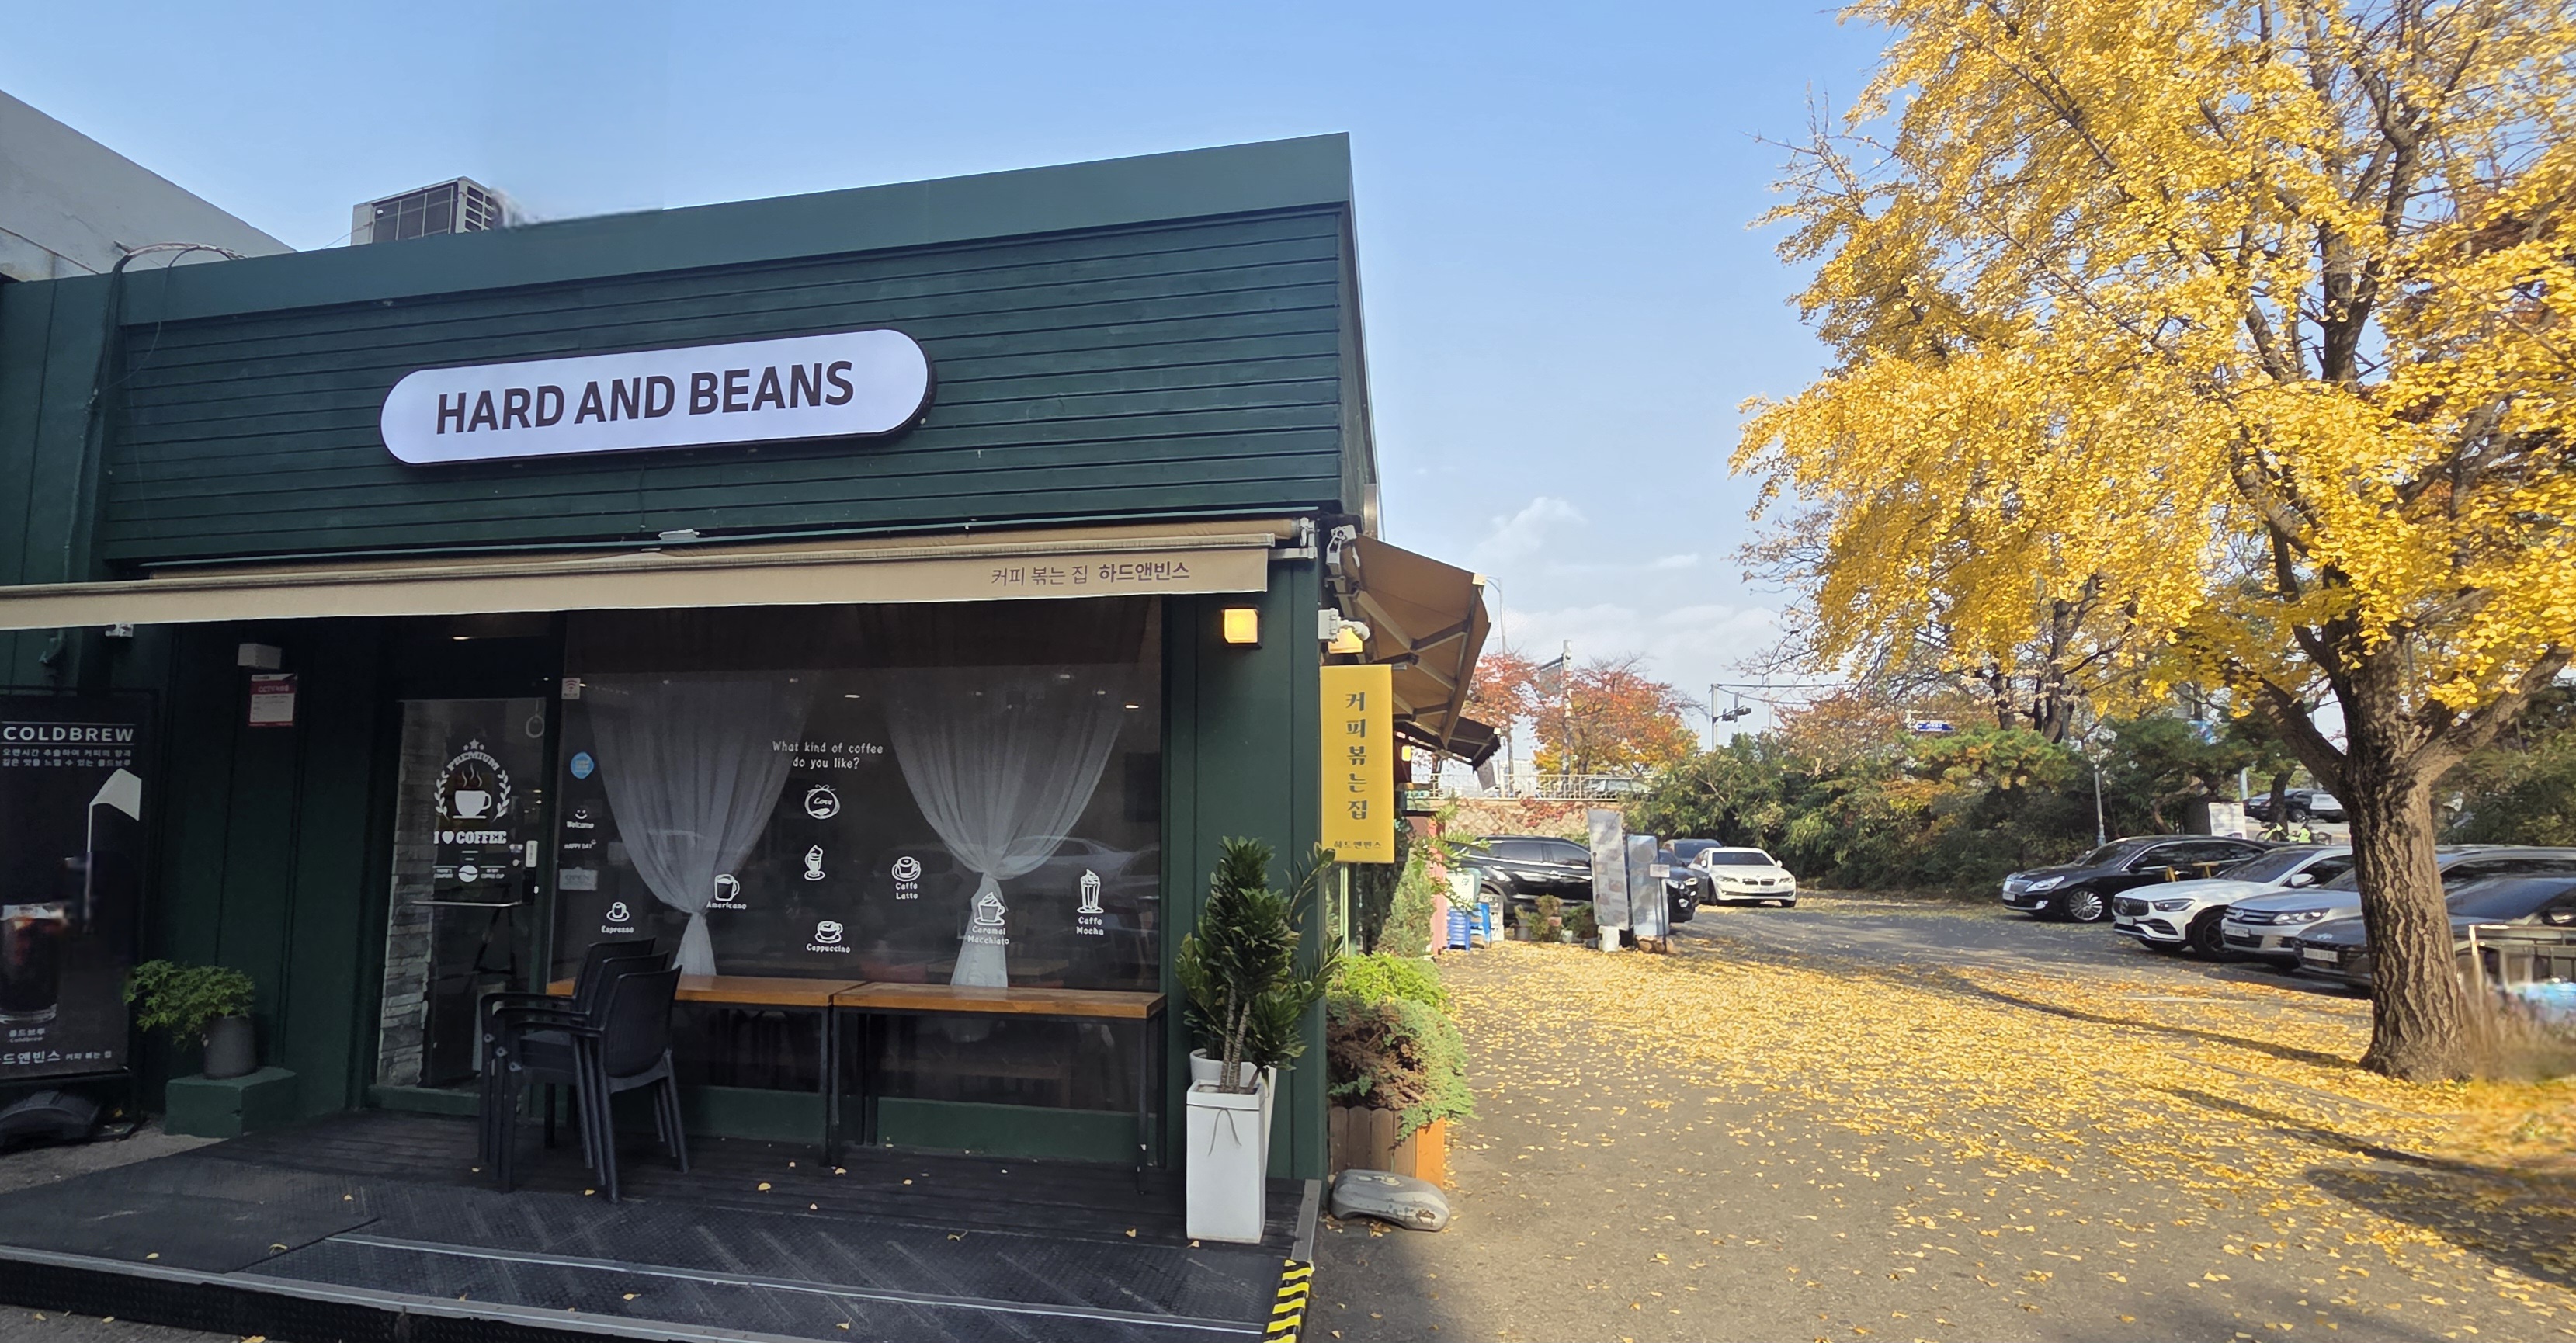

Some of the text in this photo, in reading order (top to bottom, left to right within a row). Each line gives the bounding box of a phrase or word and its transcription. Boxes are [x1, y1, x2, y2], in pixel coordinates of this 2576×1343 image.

[436, 360, 854, 435] HARD AND BEANS
[991, 560, 1190, 586] 커피 볶는 집 하드앤빈스
[3, 726, 134, 741] COLDBREW
[772, 741, 884, 754] What kind of coffee
[446, 751, 501, 772] PREMIUM
[793, 756, 860, 769] do you like?
[433, 831, 507, 845] I COFFEE
[895, 881, 918, 890] Caffe
[706, 901, 747, 910] Americano
[1078, 916, 1102, 925] Caffe
[601, 925, 634, 934] Espresso
[971, 925, 1006, 935] Caramel
[1076, 926, 1104, 935] Mocha
[967, 935, 1010, 946] Macchiato
[806, 942, 851, 953] Cappuccino
[0, 1050, 61, 1065] 드앤빈스
